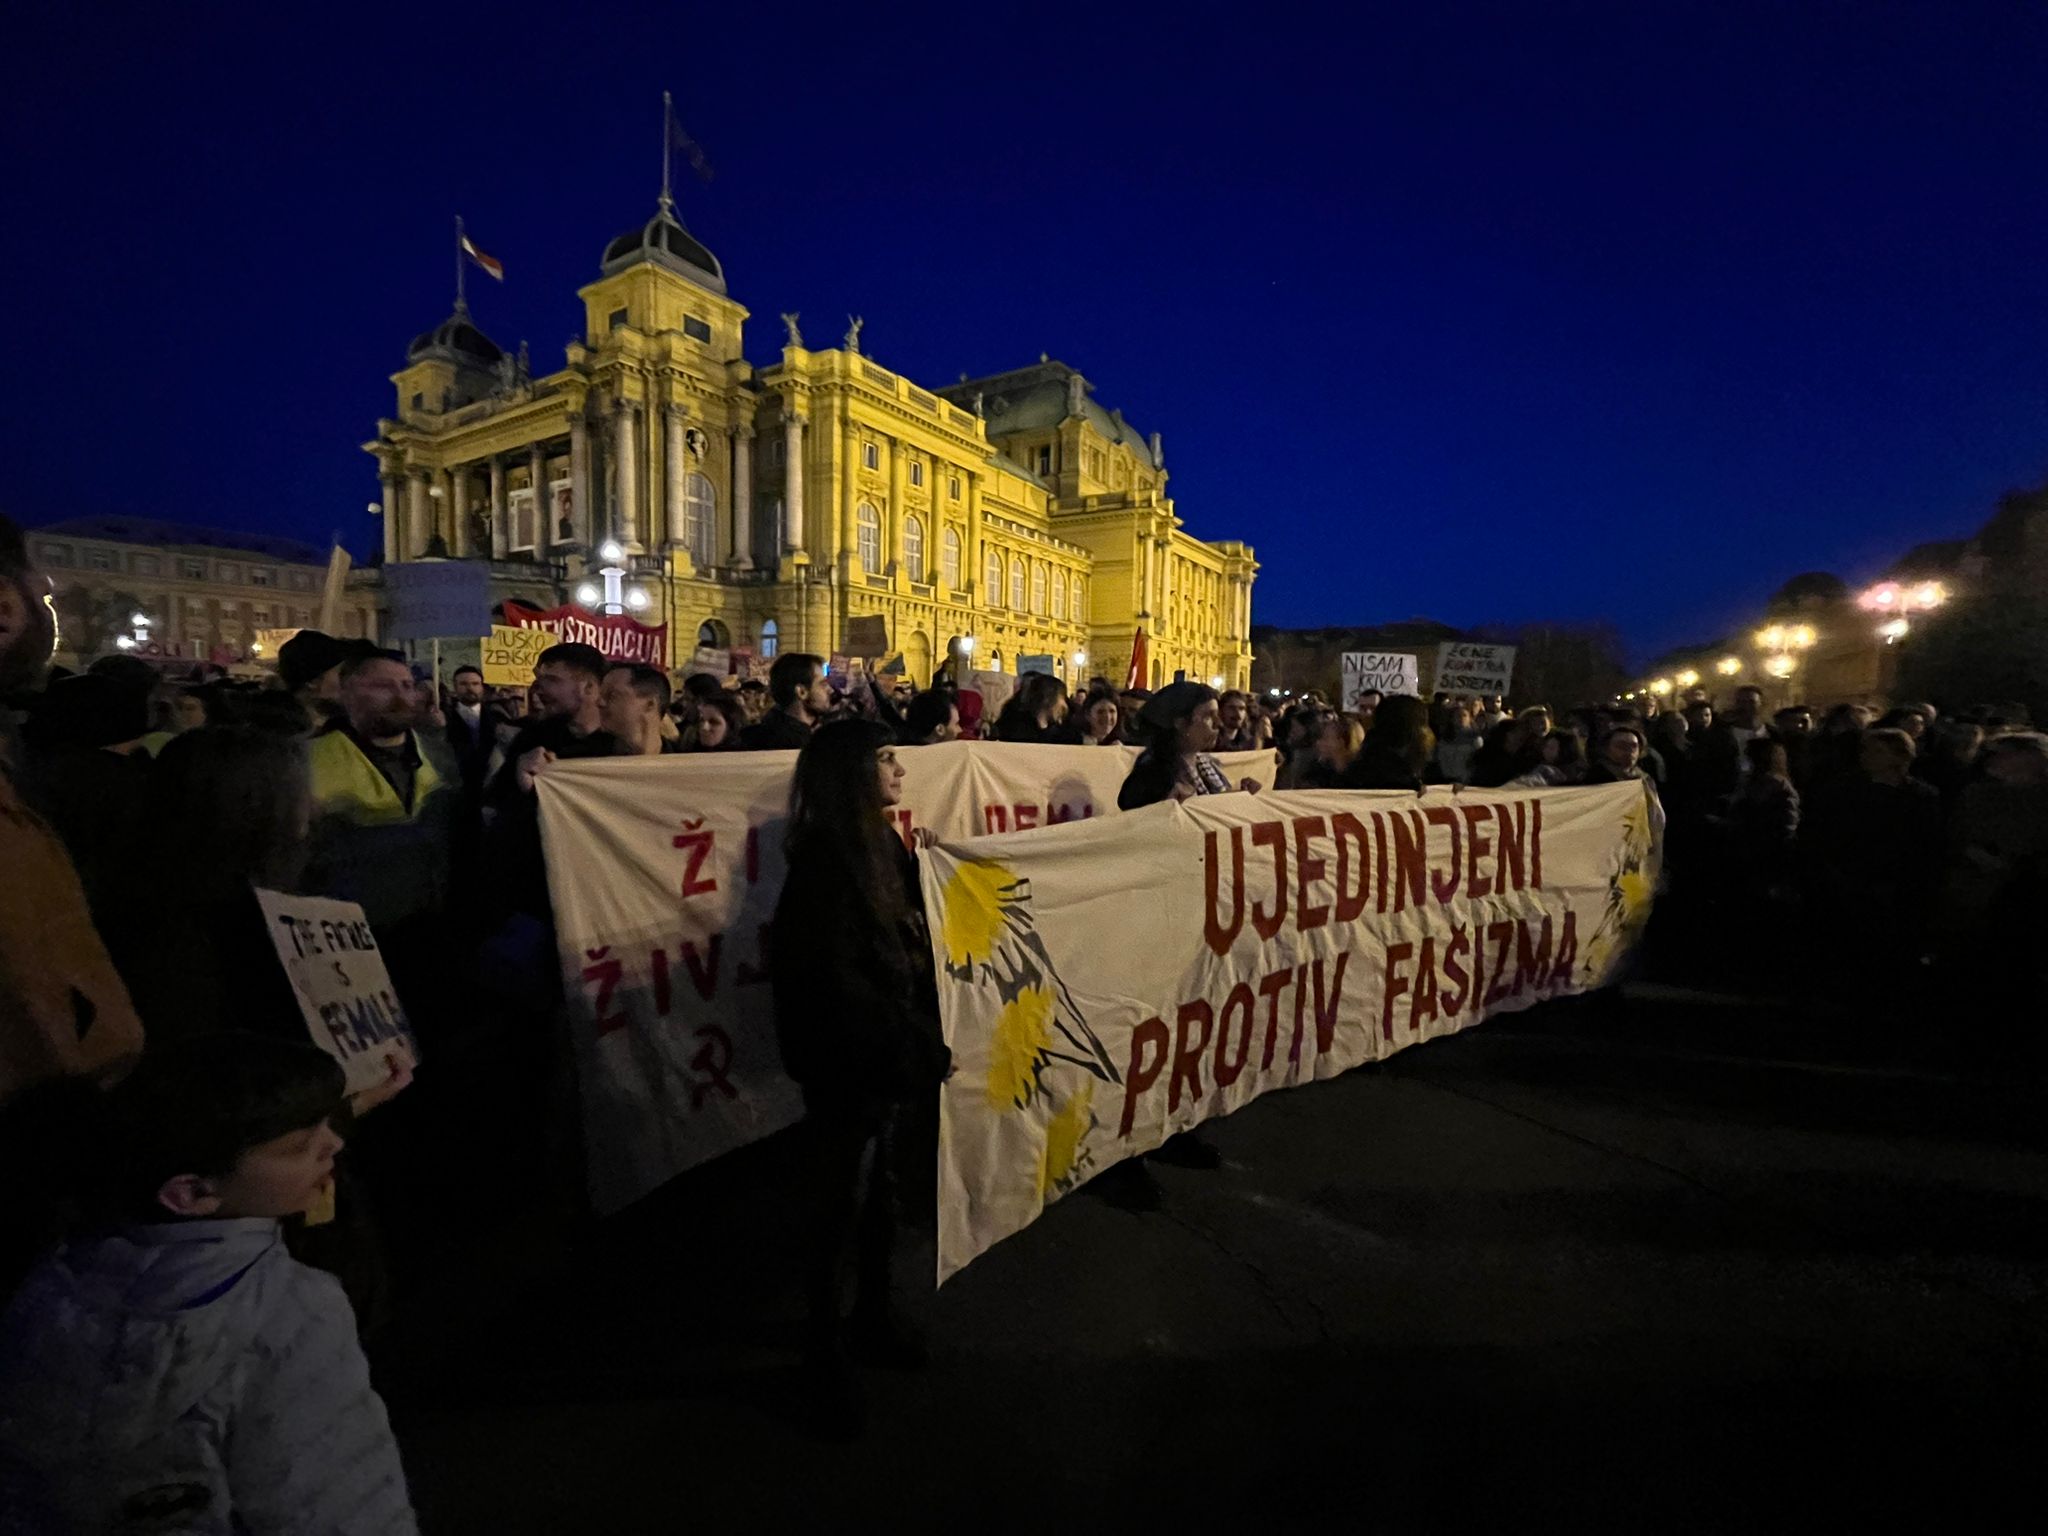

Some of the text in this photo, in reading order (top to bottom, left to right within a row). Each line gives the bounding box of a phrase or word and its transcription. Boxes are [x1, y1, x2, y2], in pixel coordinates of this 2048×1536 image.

[1344, 654, 1404, 674] NISAM
[1358, 673, 1405, 690] KRIVO
[1439, 674, 1505, 691] SISTEMA
[1203, 799, 1542, 956] UJEDINJENI
[1117, 911, 1577, 1138] PROTIV FAŠIZMA
